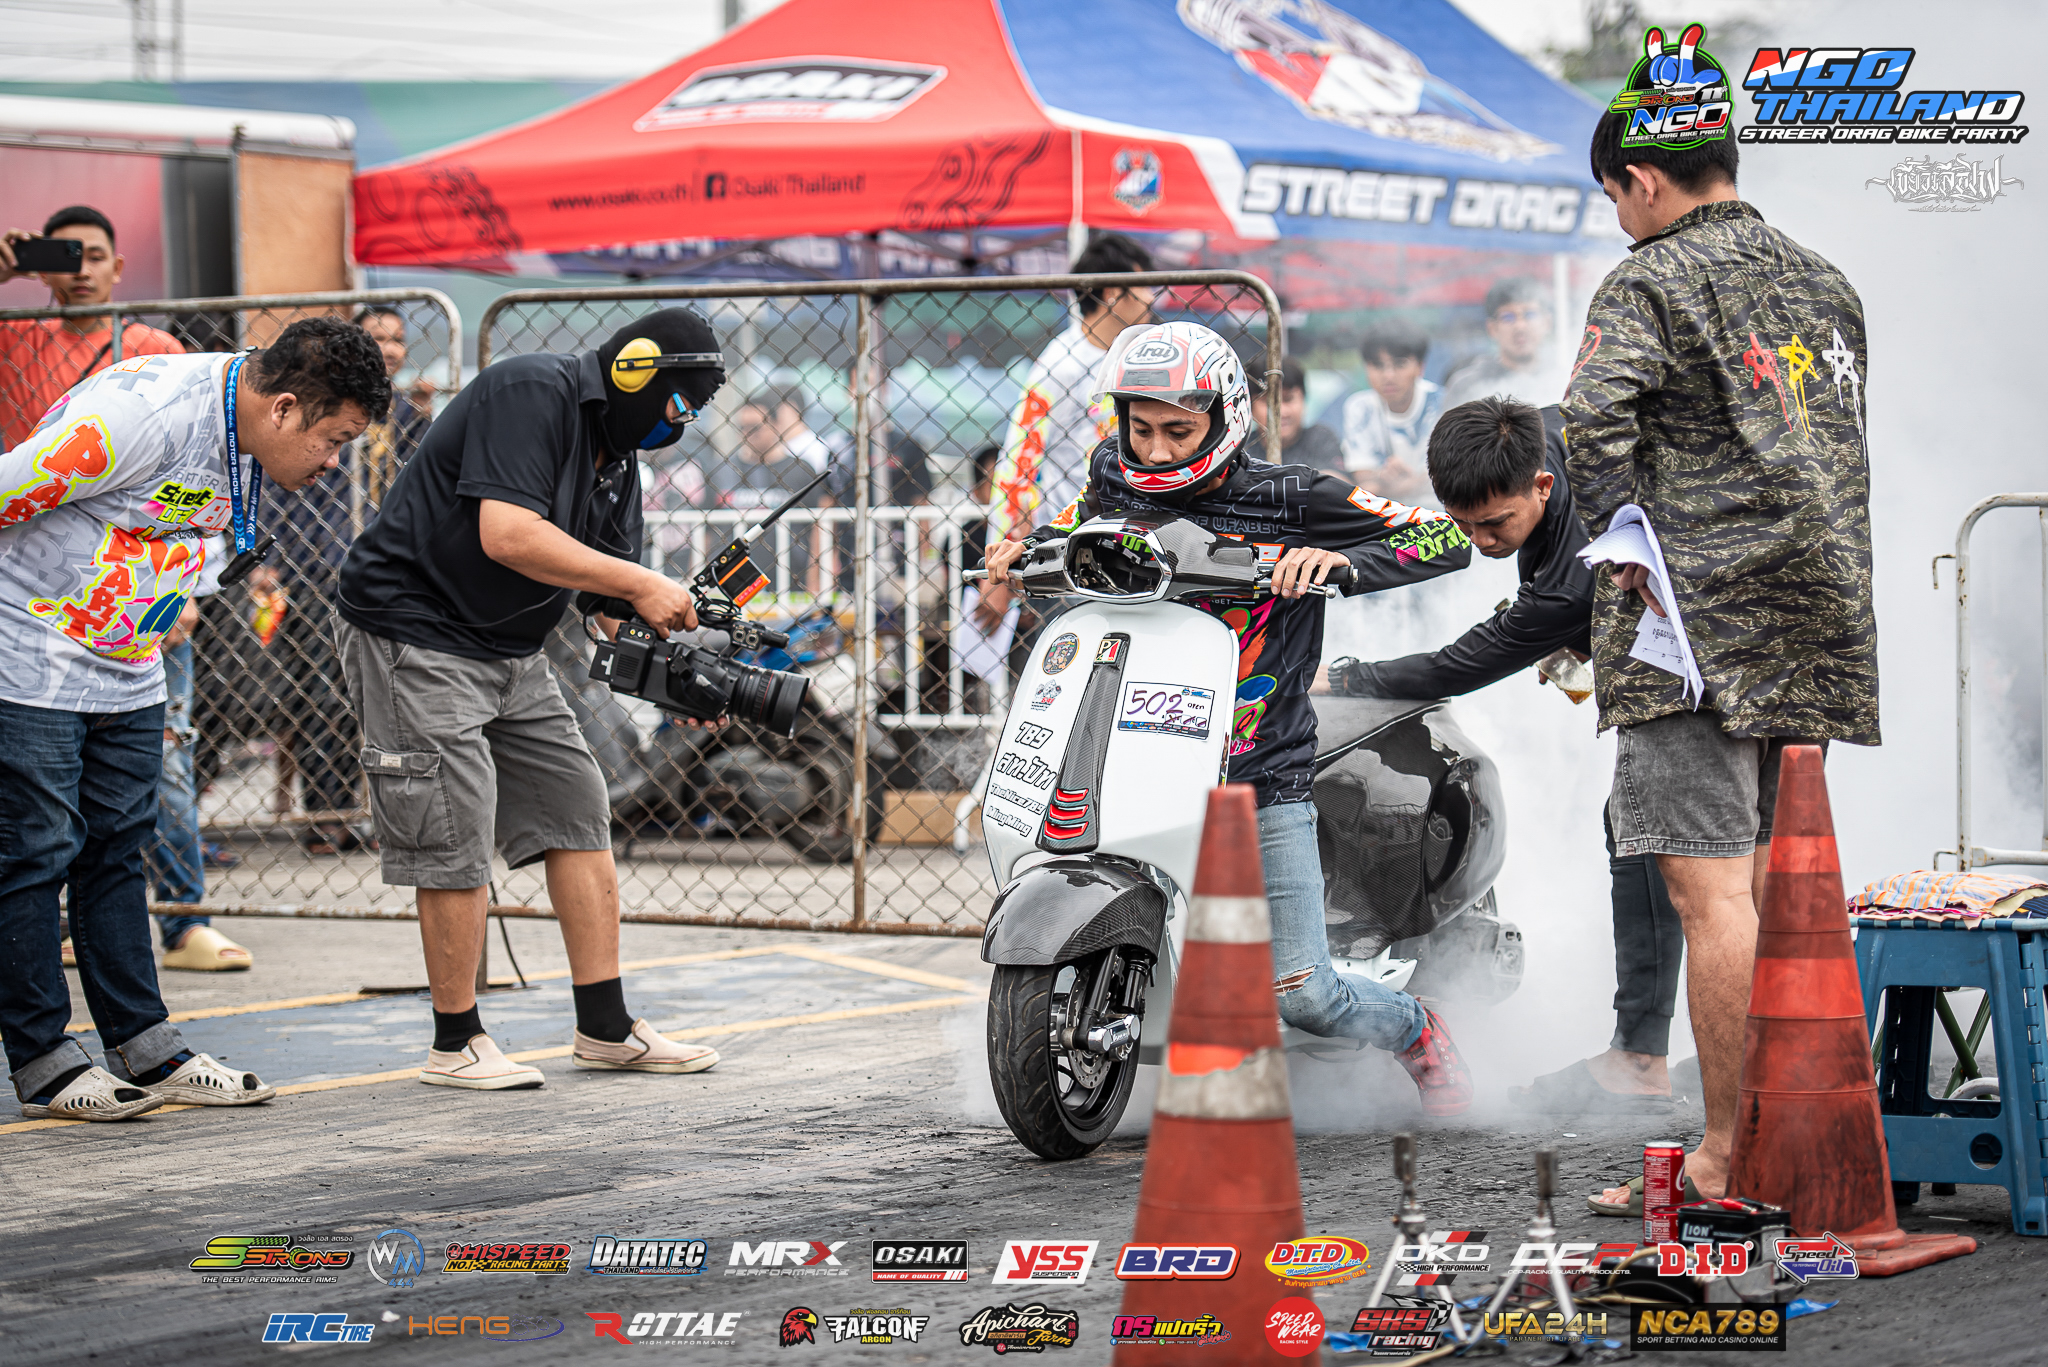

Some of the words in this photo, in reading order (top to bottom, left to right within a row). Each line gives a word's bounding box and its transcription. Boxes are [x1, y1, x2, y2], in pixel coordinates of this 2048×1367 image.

[786, 171, 864, 195] Thailand
[1244, 164, 1449, 224] STREET
[1449, 180, 1580, 233] DRAG
[1132, 342, 1172, 358] Arai
[229, 431, 238, 466] MOTOR
[231, 467, 240, 496] SHOW
[248, 505, 256, 522] Keep
[1211, 516, 1282, 534] UFABET
[1126, 688, 1184, 716] 502
[1014, 720, 1054, 749] 789
[990, 783, 1046, 815] TheNice789
[986, 805, 1033, 837] MingMing
[1682, 1223, 1714, 1242] LION
